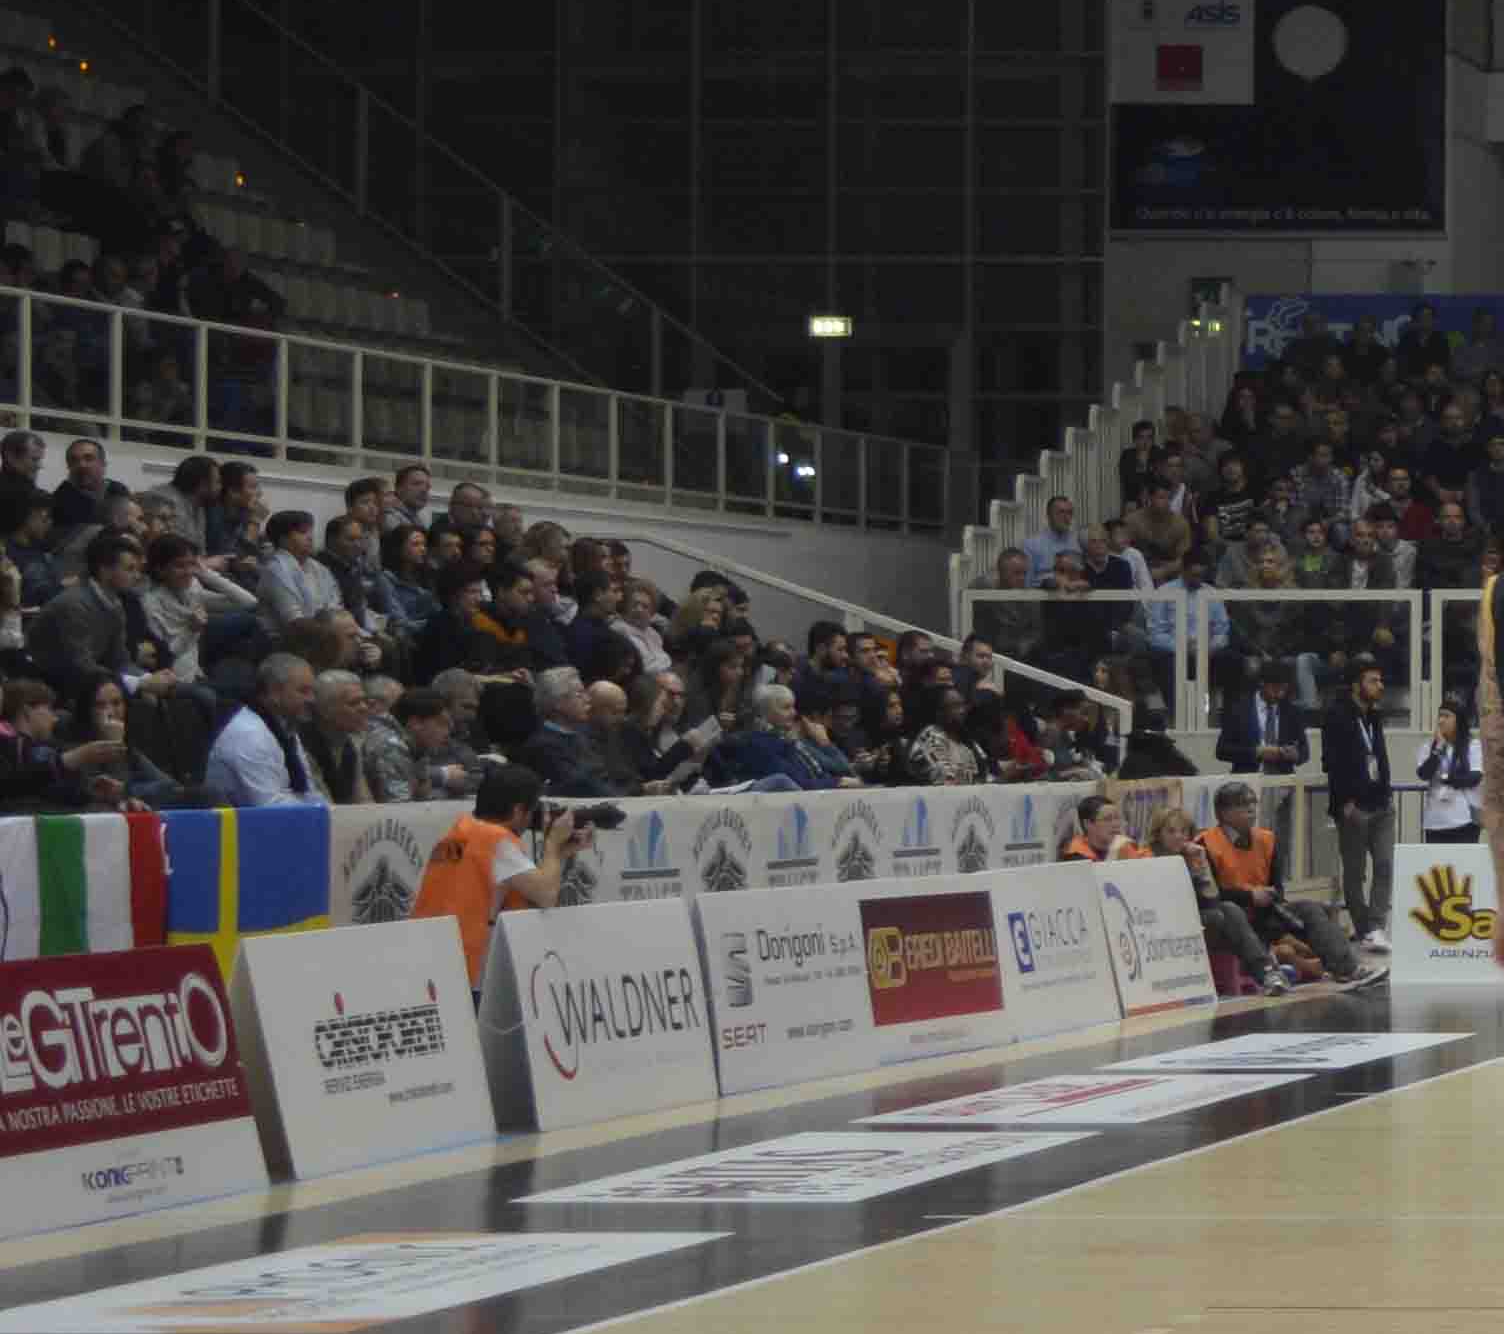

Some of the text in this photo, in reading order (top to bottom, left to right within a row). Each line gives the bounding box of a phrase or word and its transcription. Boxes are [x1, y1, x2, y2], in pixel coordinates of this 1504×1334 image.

[757, 923, 825, 967] Dorigoni
[549, 966, 702, 1047] WALDNER
[722, 1022, 767, 1051] SEAT
[9, 1107, 60, 1132] NOSTRA
[136, 1086, 182, 1111] VOSTRE
[182, 1077, 241, 1105] ETICHETTE
